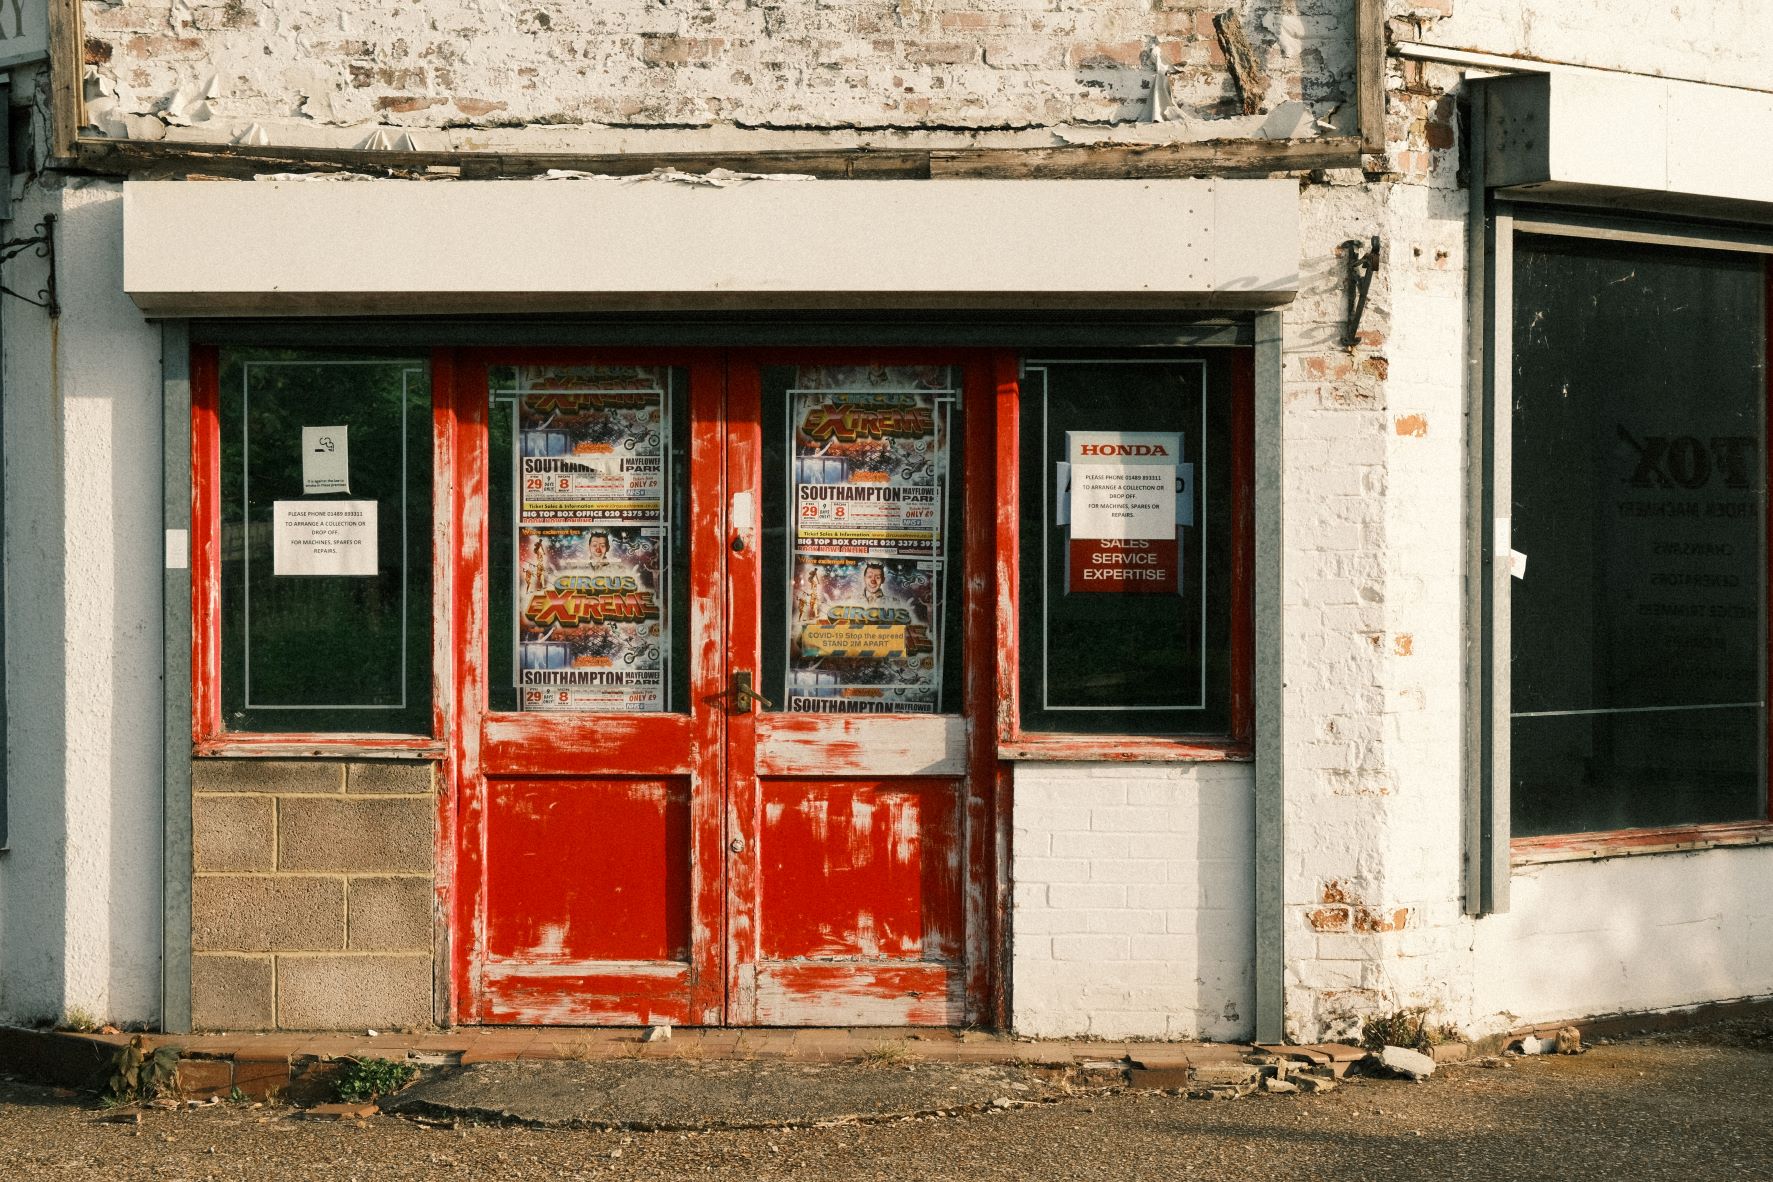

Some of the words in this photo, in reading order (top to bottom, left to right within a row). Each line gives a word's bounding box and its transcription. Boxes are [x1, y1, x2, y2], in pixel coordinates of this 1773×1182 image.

[802, 403, 936, 442] EXTREME
[1080, 444, 1169, 456] HONDA
[527, 479, 542, 489] 29
[559, 479, 569, 489] 8
[800, 485, 901, 501] SOUTHAMPTON
[802, 506, 817, 517] 29
[835, 507, 845, 517] 8
[905, 510, 923, 518] ONLY
[1100, 539, 1150, 548] SALES
[1092, 553, 1158, 564] SERVICE
[1083, 569, 1166, 580] EXPERTISE
[554, 575, 639, 594] CIRCUS
[525, 589, 661, 628] EXTREME
[827, 605, 912, 624] CIRCUS
[845, 632, 863, 640] Stop
[878, 632, 904, 641] spread
[525, 671, 624, 685] SOUTHAMPTON
[526, 691, 541, 701] 29
[559, 691, 569, 701] 8
[629, 694, 647, 702] ONLY
[793, 698, 894, 713] SOUTHAMPTON
[894, 703, 932, 711] MAYFLOWER
